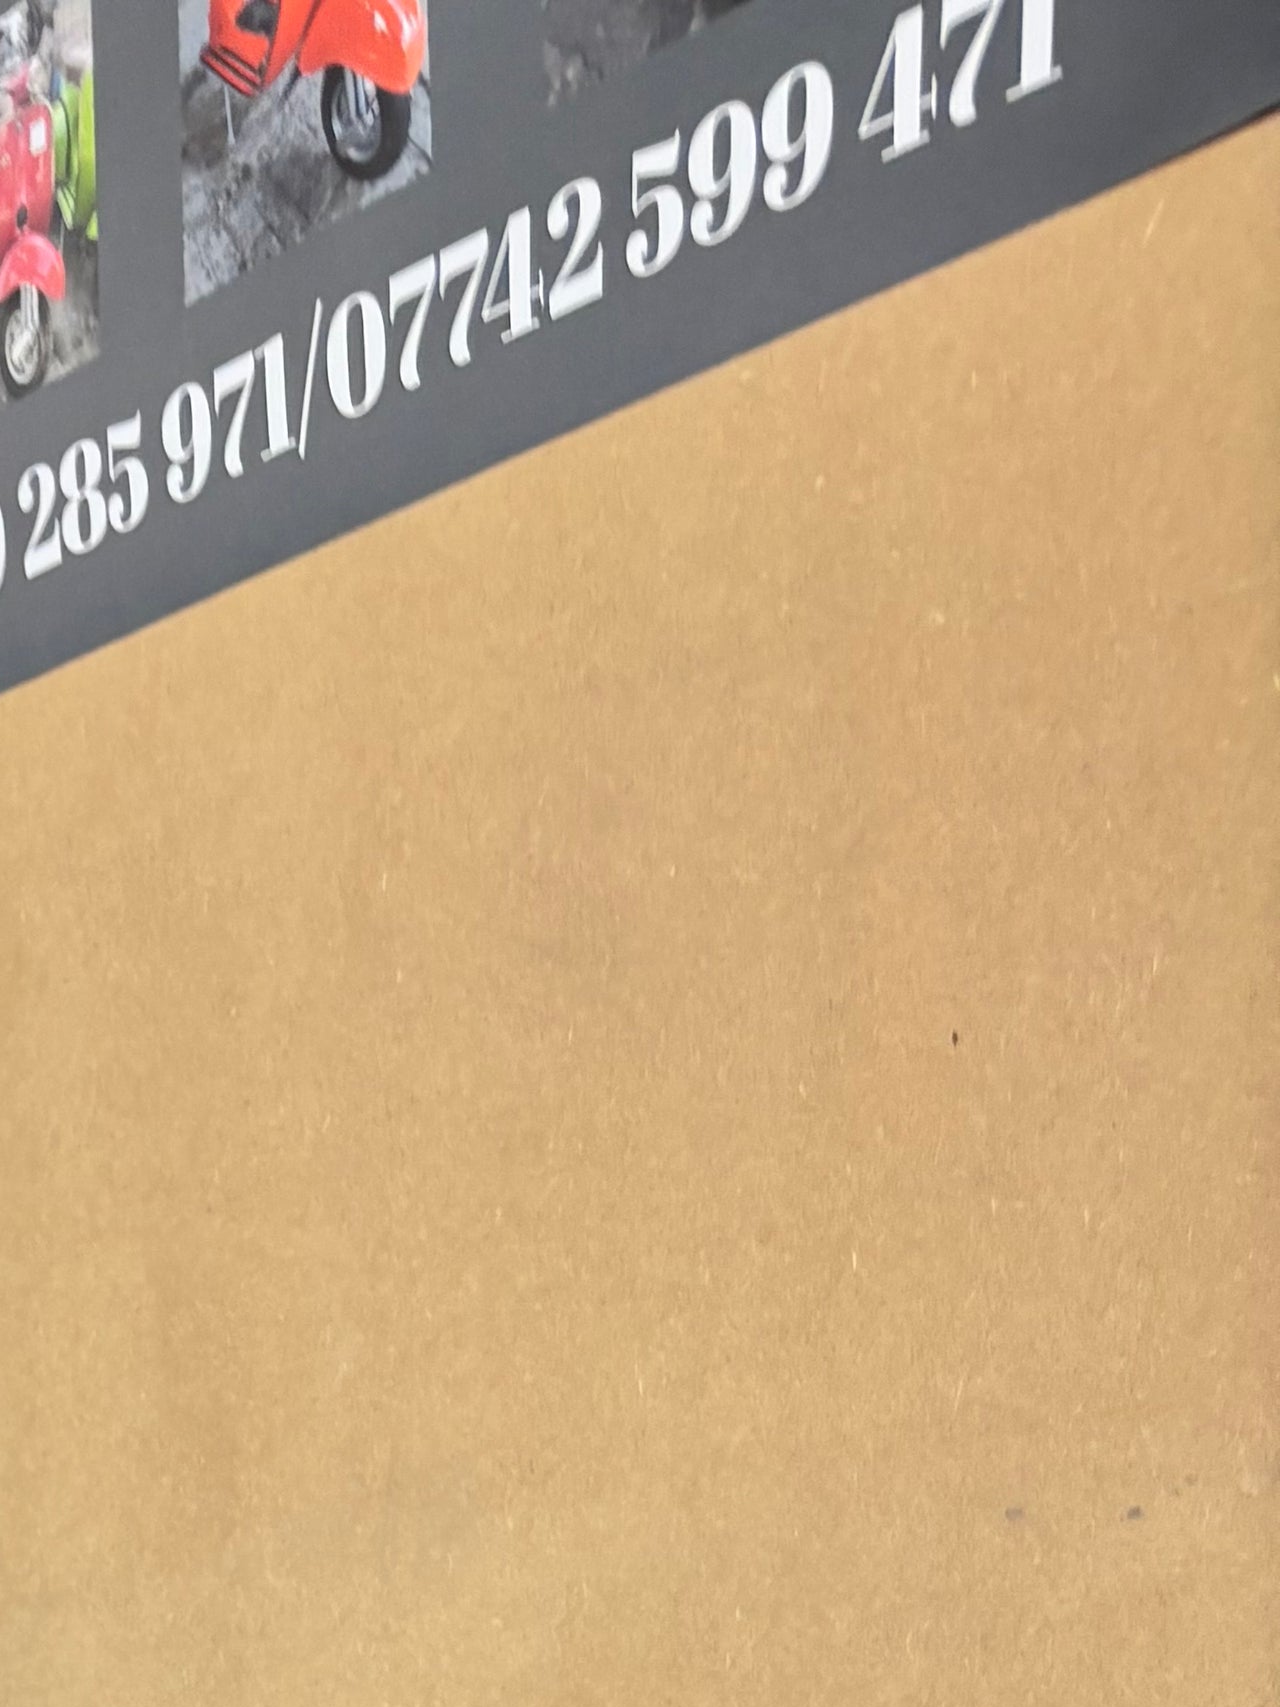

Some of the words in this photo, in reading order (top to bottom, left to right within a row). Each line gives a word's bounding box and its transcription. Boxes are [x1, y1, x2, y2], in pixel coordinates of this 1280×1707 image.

[16, 410, 149, 580] 285
[161, 176, 604, 505] 971/07742
[625, 61, 834, 278] 599
[857, 0, 1063, 163] 471
